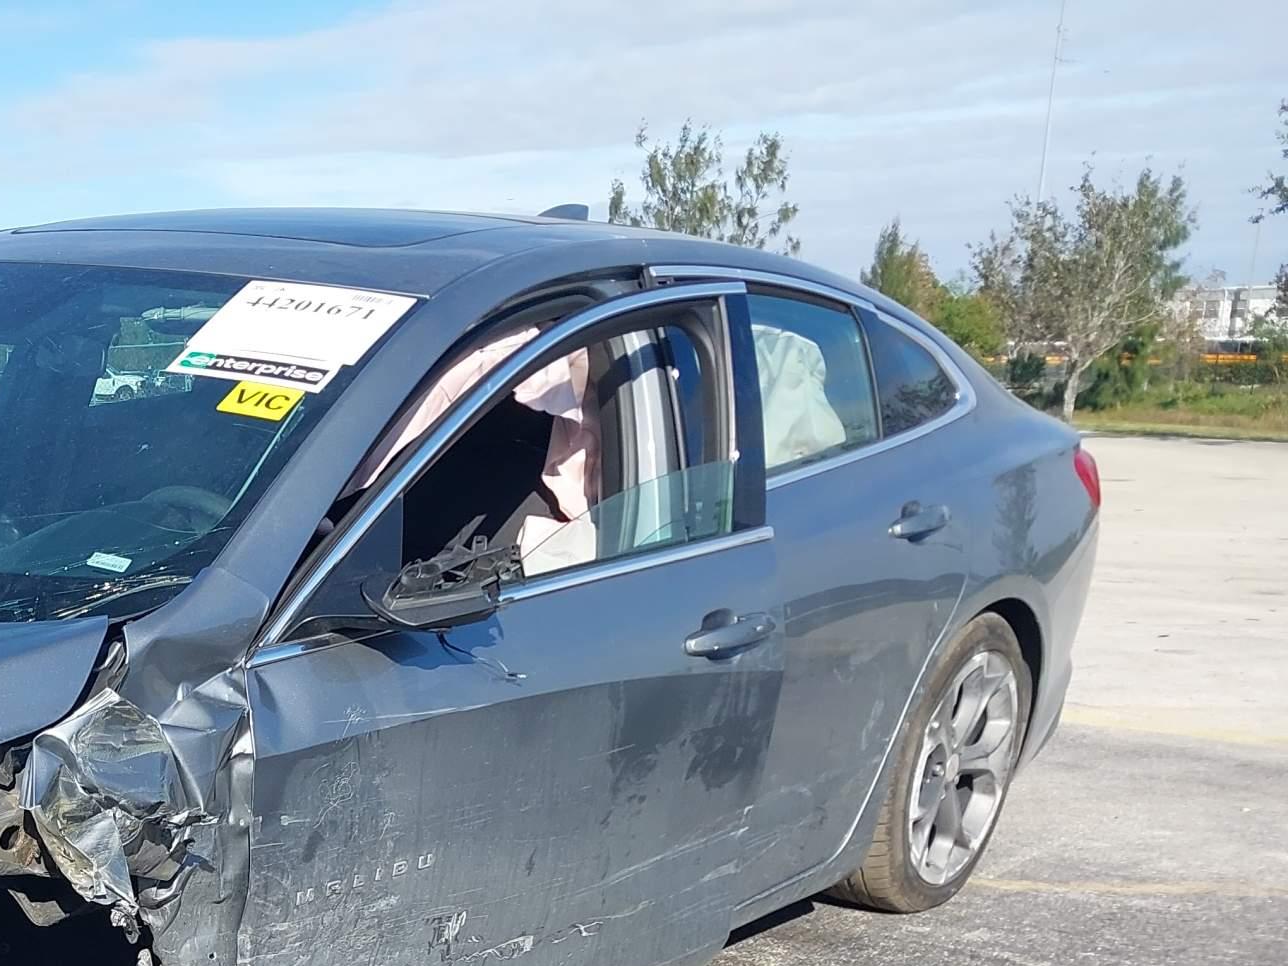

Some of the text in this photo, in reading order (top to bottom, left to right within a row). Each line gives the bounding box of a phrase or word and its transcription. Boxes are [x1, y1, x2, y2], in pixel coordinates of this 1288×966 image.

[247, 295, 376, 320] 44201671
[189, 353, 325, 382] enterprise
[235, 390, 291, 411] VIC
